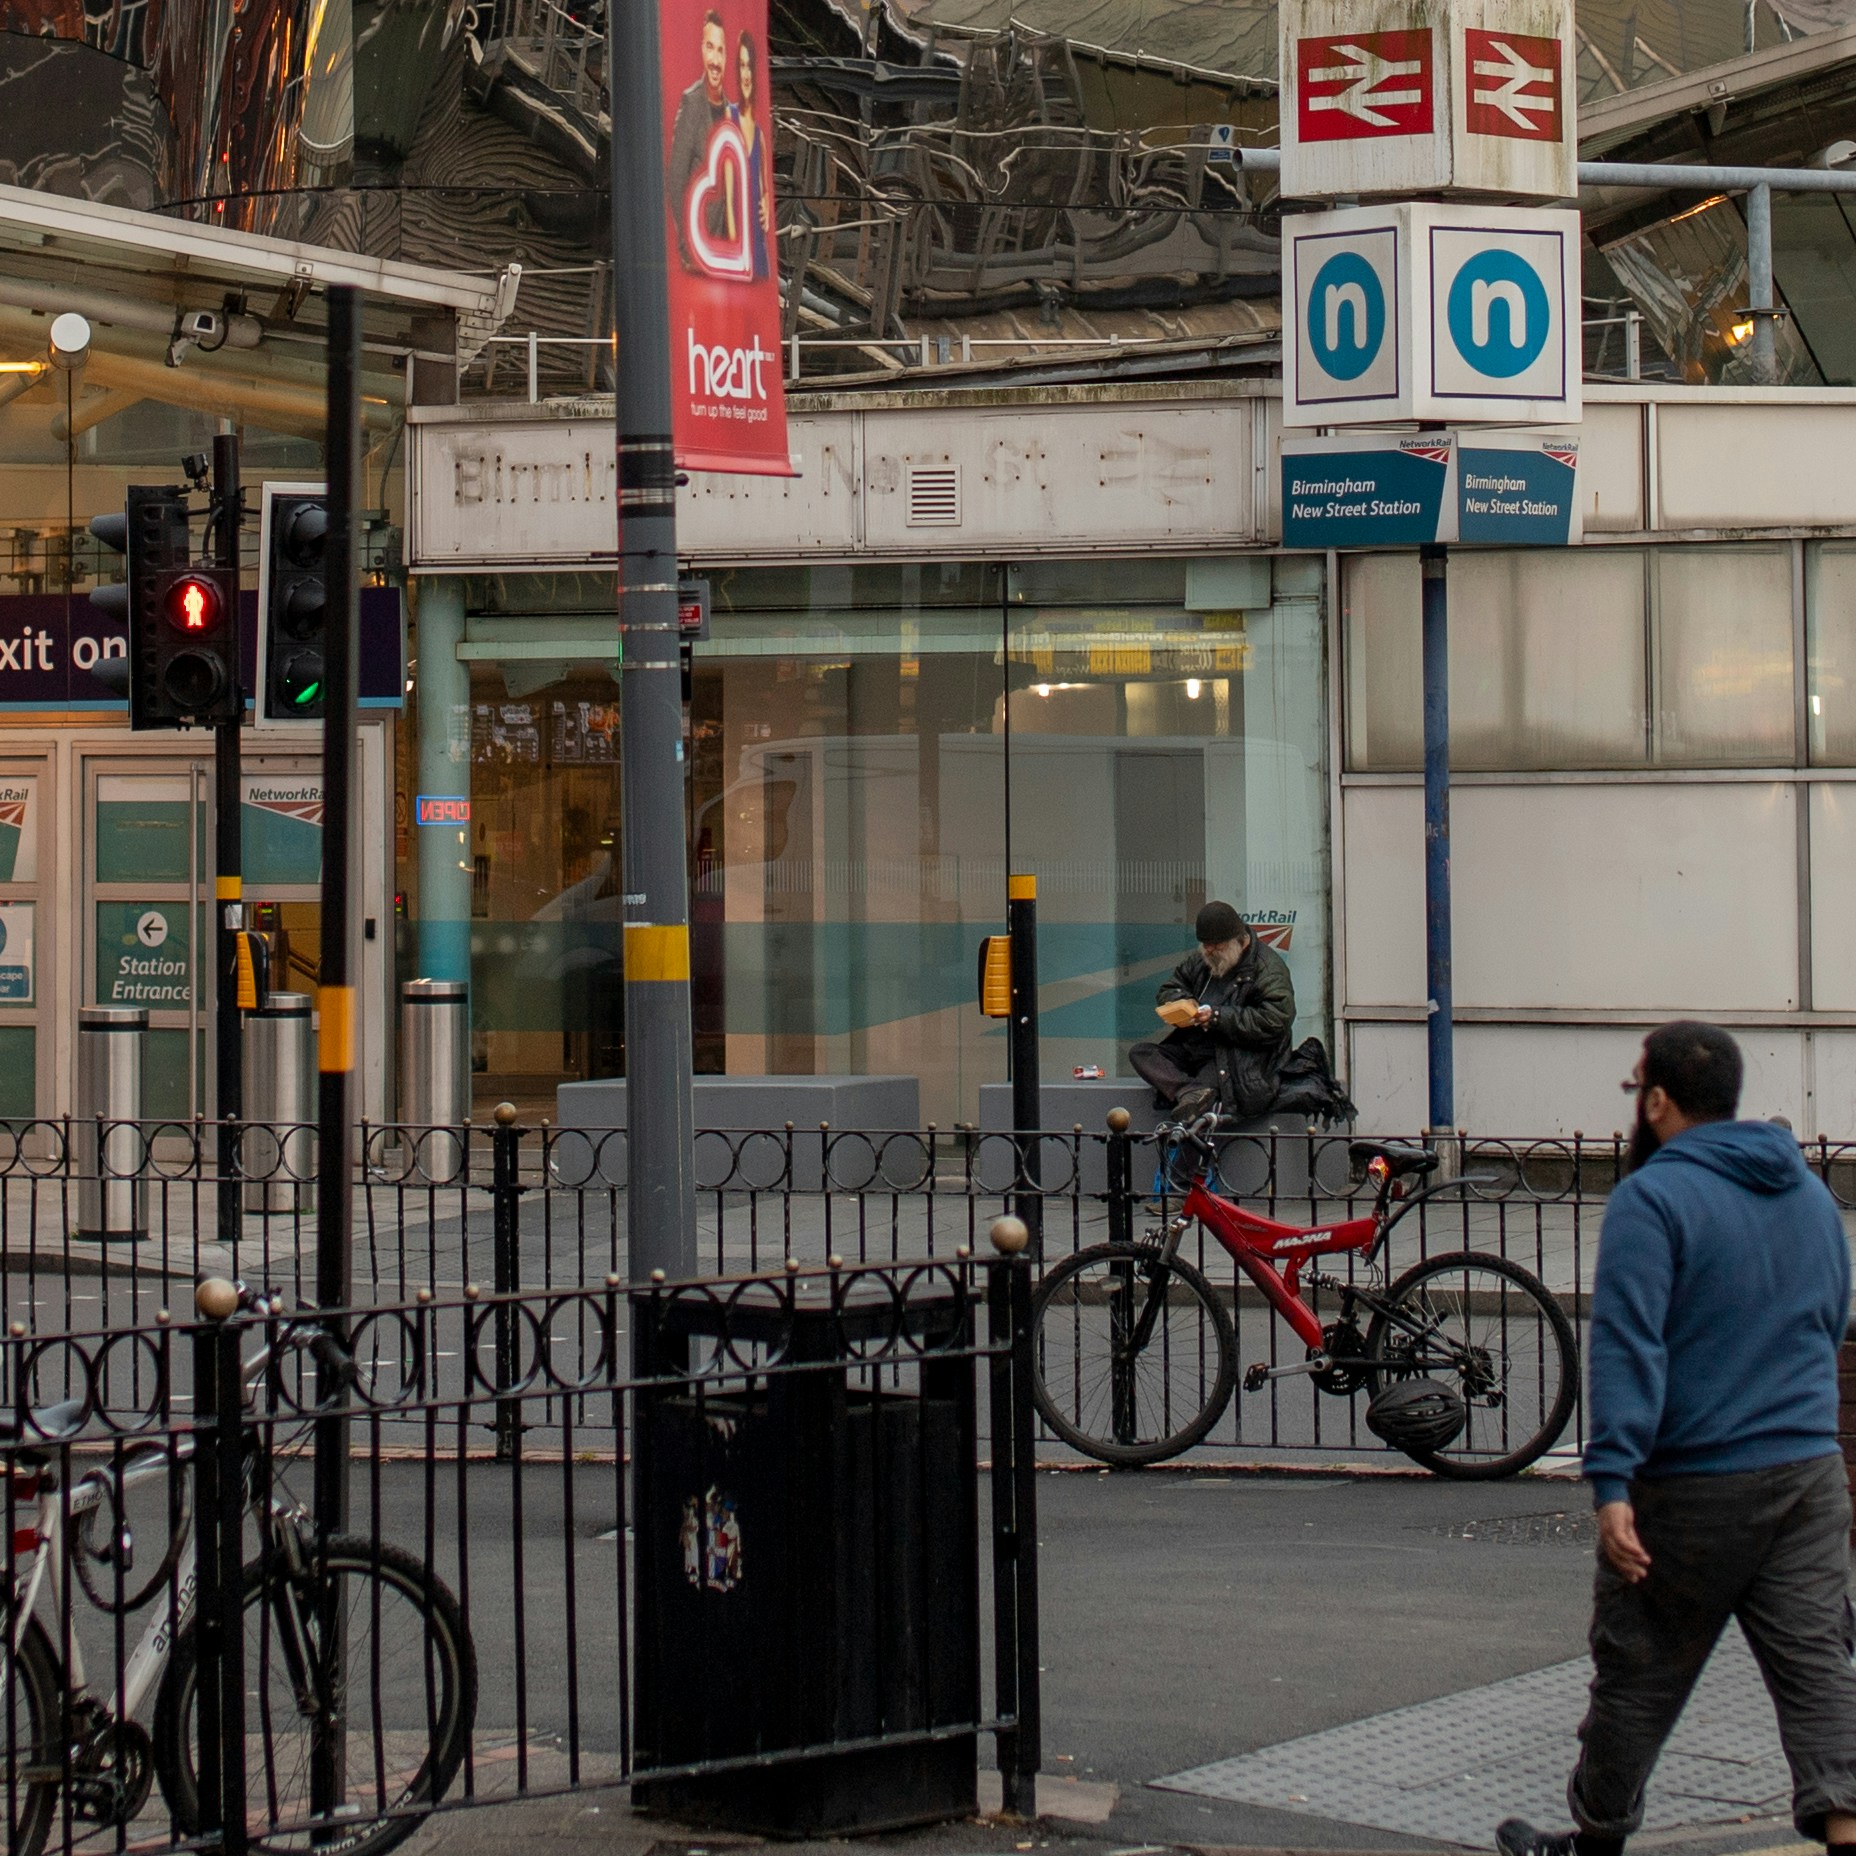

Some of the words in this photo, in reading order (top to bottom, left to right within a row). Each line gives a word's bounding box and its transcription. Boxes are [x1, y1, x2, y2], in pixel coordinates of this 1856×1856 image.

[687, 327, 767, 400] heart
[691, 402, 707, 417] turn
[708, 405, 718, 420] up
[719, 404, 732, 419] the
[732, 405, 746, 420] feel
[1399, 437, 1452, 449] NetworkRail
[1542, 442, 1579, 452] NetworkRail
[1291, 478, 1375, 497] Birmingham
[1465, 474, 1526, 494] Birmingham
[1291, 502, 1323, 519] New
[1326, 501, 1368, 517] Street
[1370, 499, 1421, 515] Station
[1466, 498, 1489, 514] New
[1490, 498, 1520, 515] Street
[1522, 499, 1558, 515] Station
[119, 956, 186, 976] Station
[111, 980, 191, 1000] Entrance
